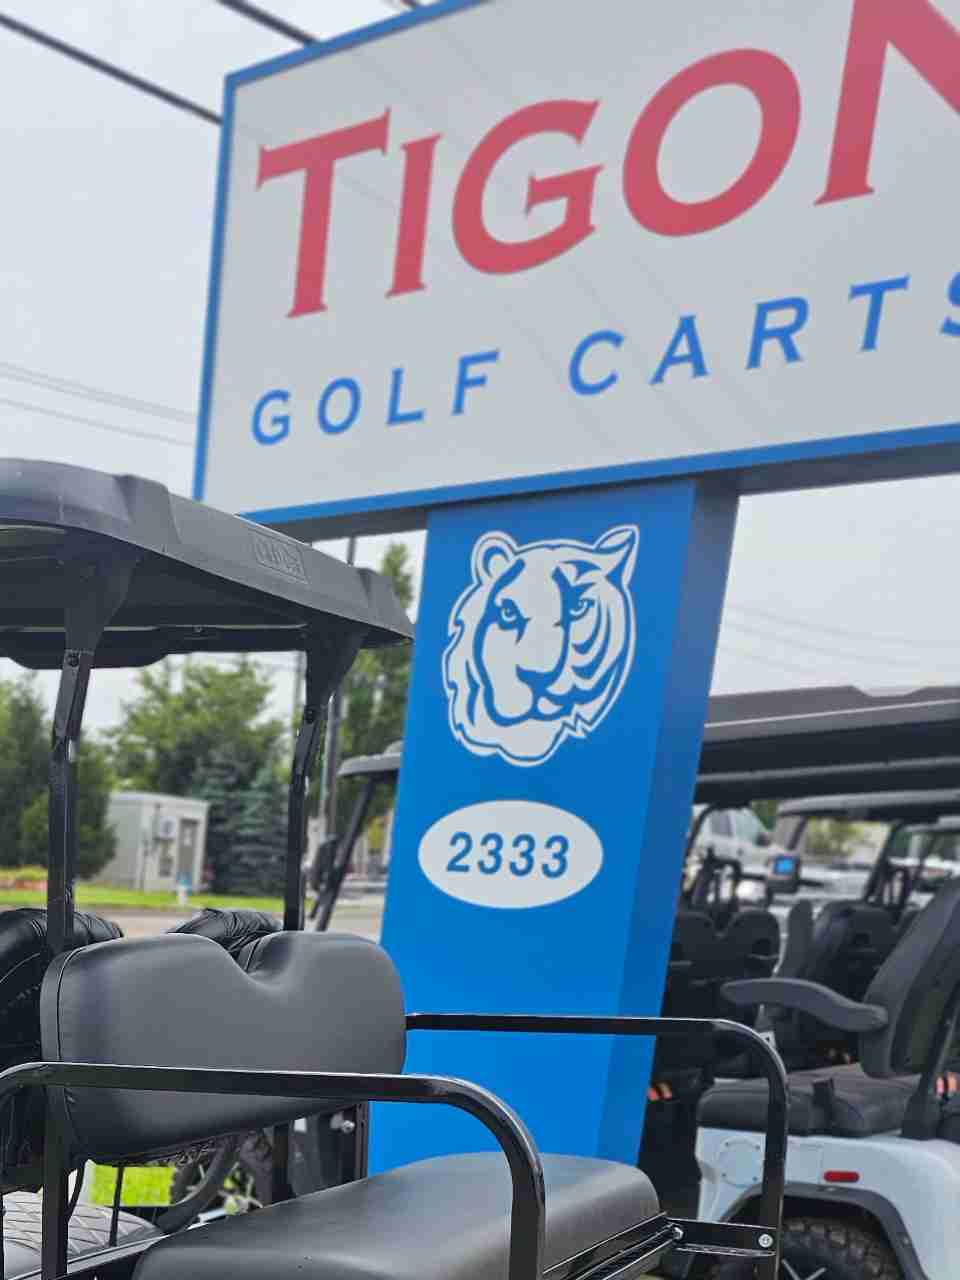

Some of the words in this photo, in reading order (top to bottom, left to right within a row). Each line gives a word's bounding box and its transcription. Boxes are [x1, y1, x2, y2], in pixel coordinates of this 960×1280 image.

[257, 0, 960, 318] TIGON
[251, 351, 499, 446] GOLF
[446, 831, 570, 879] 2333
